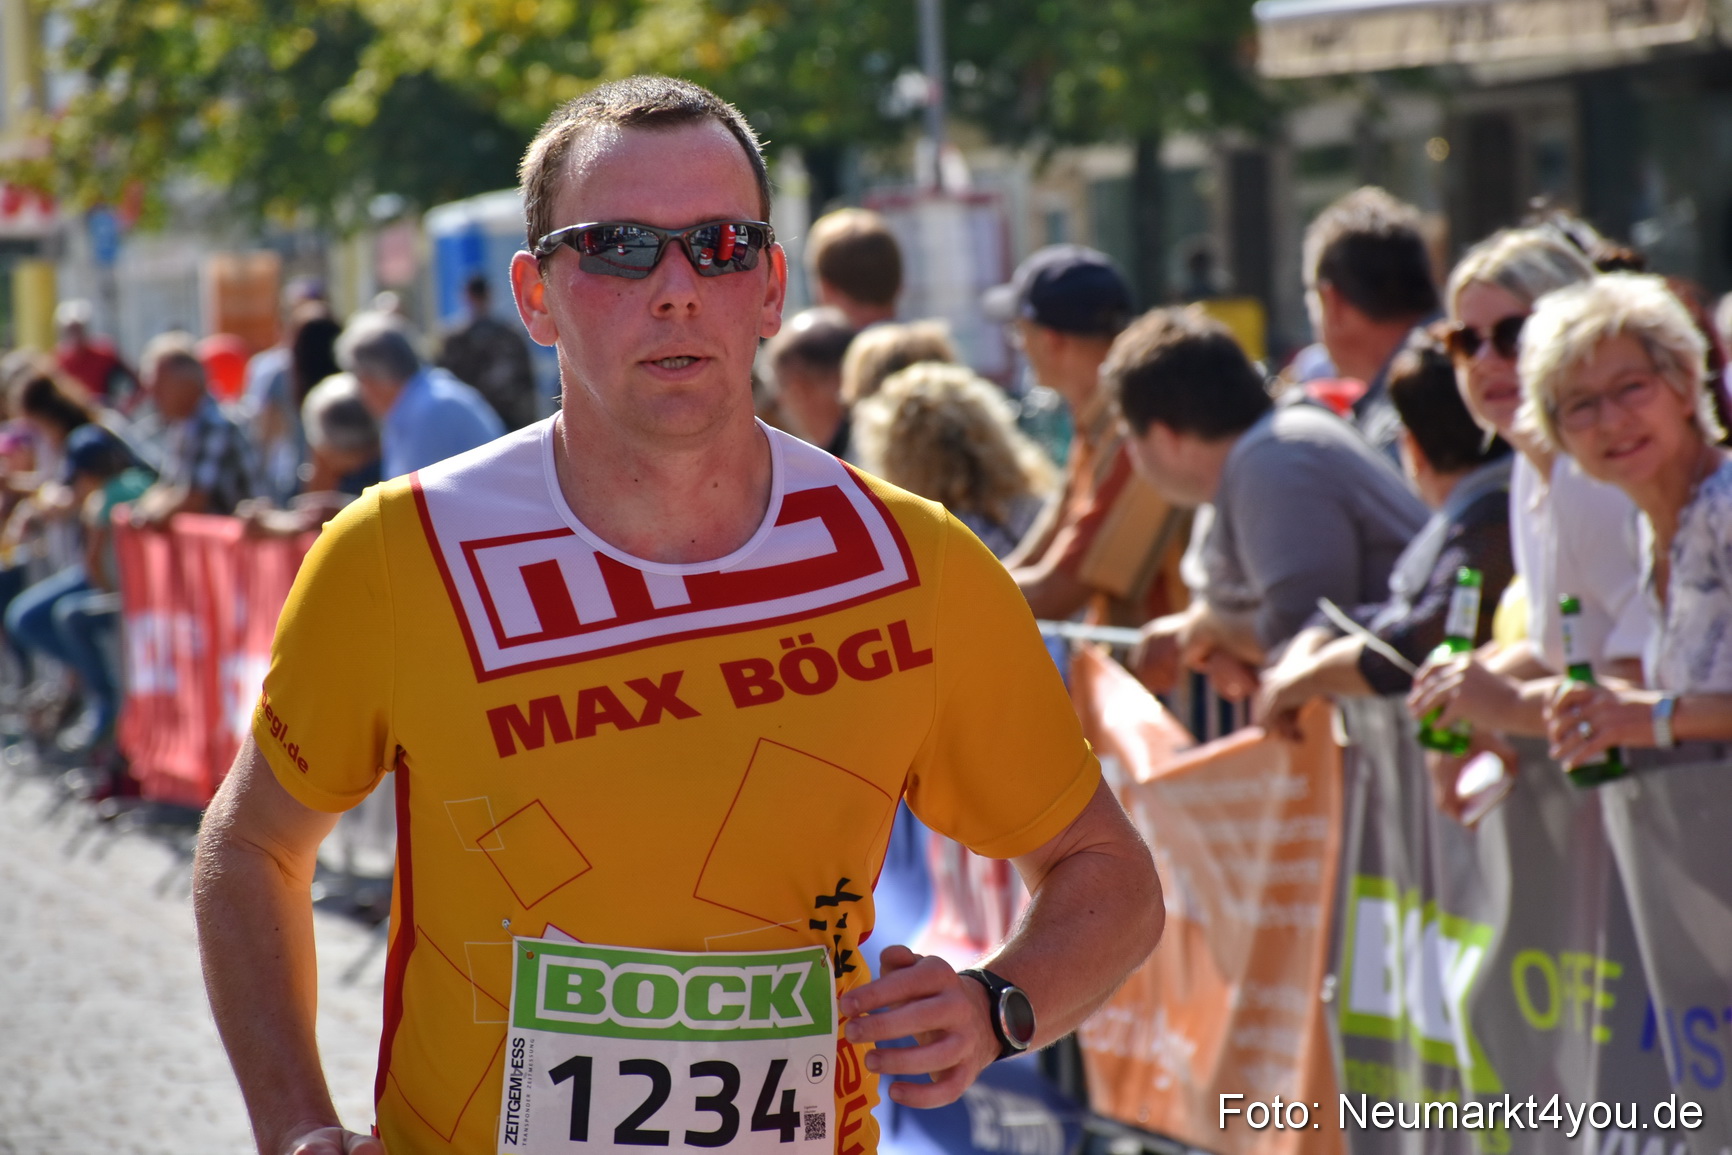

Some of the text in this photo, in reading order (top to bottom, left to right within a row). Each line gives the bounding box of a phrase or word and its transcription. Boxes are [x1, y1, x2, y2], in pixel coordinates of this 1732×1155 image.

[486, 619, 934, 759] MAX BÖGL
[540, 959, 811, 1027] BOCK
[522, 1038, 536, 1146] TRANSPONDER ZEITMESSUNG
[548, 1055, 801, 1148] 1234
[812, 1061, 823, 1077] B
